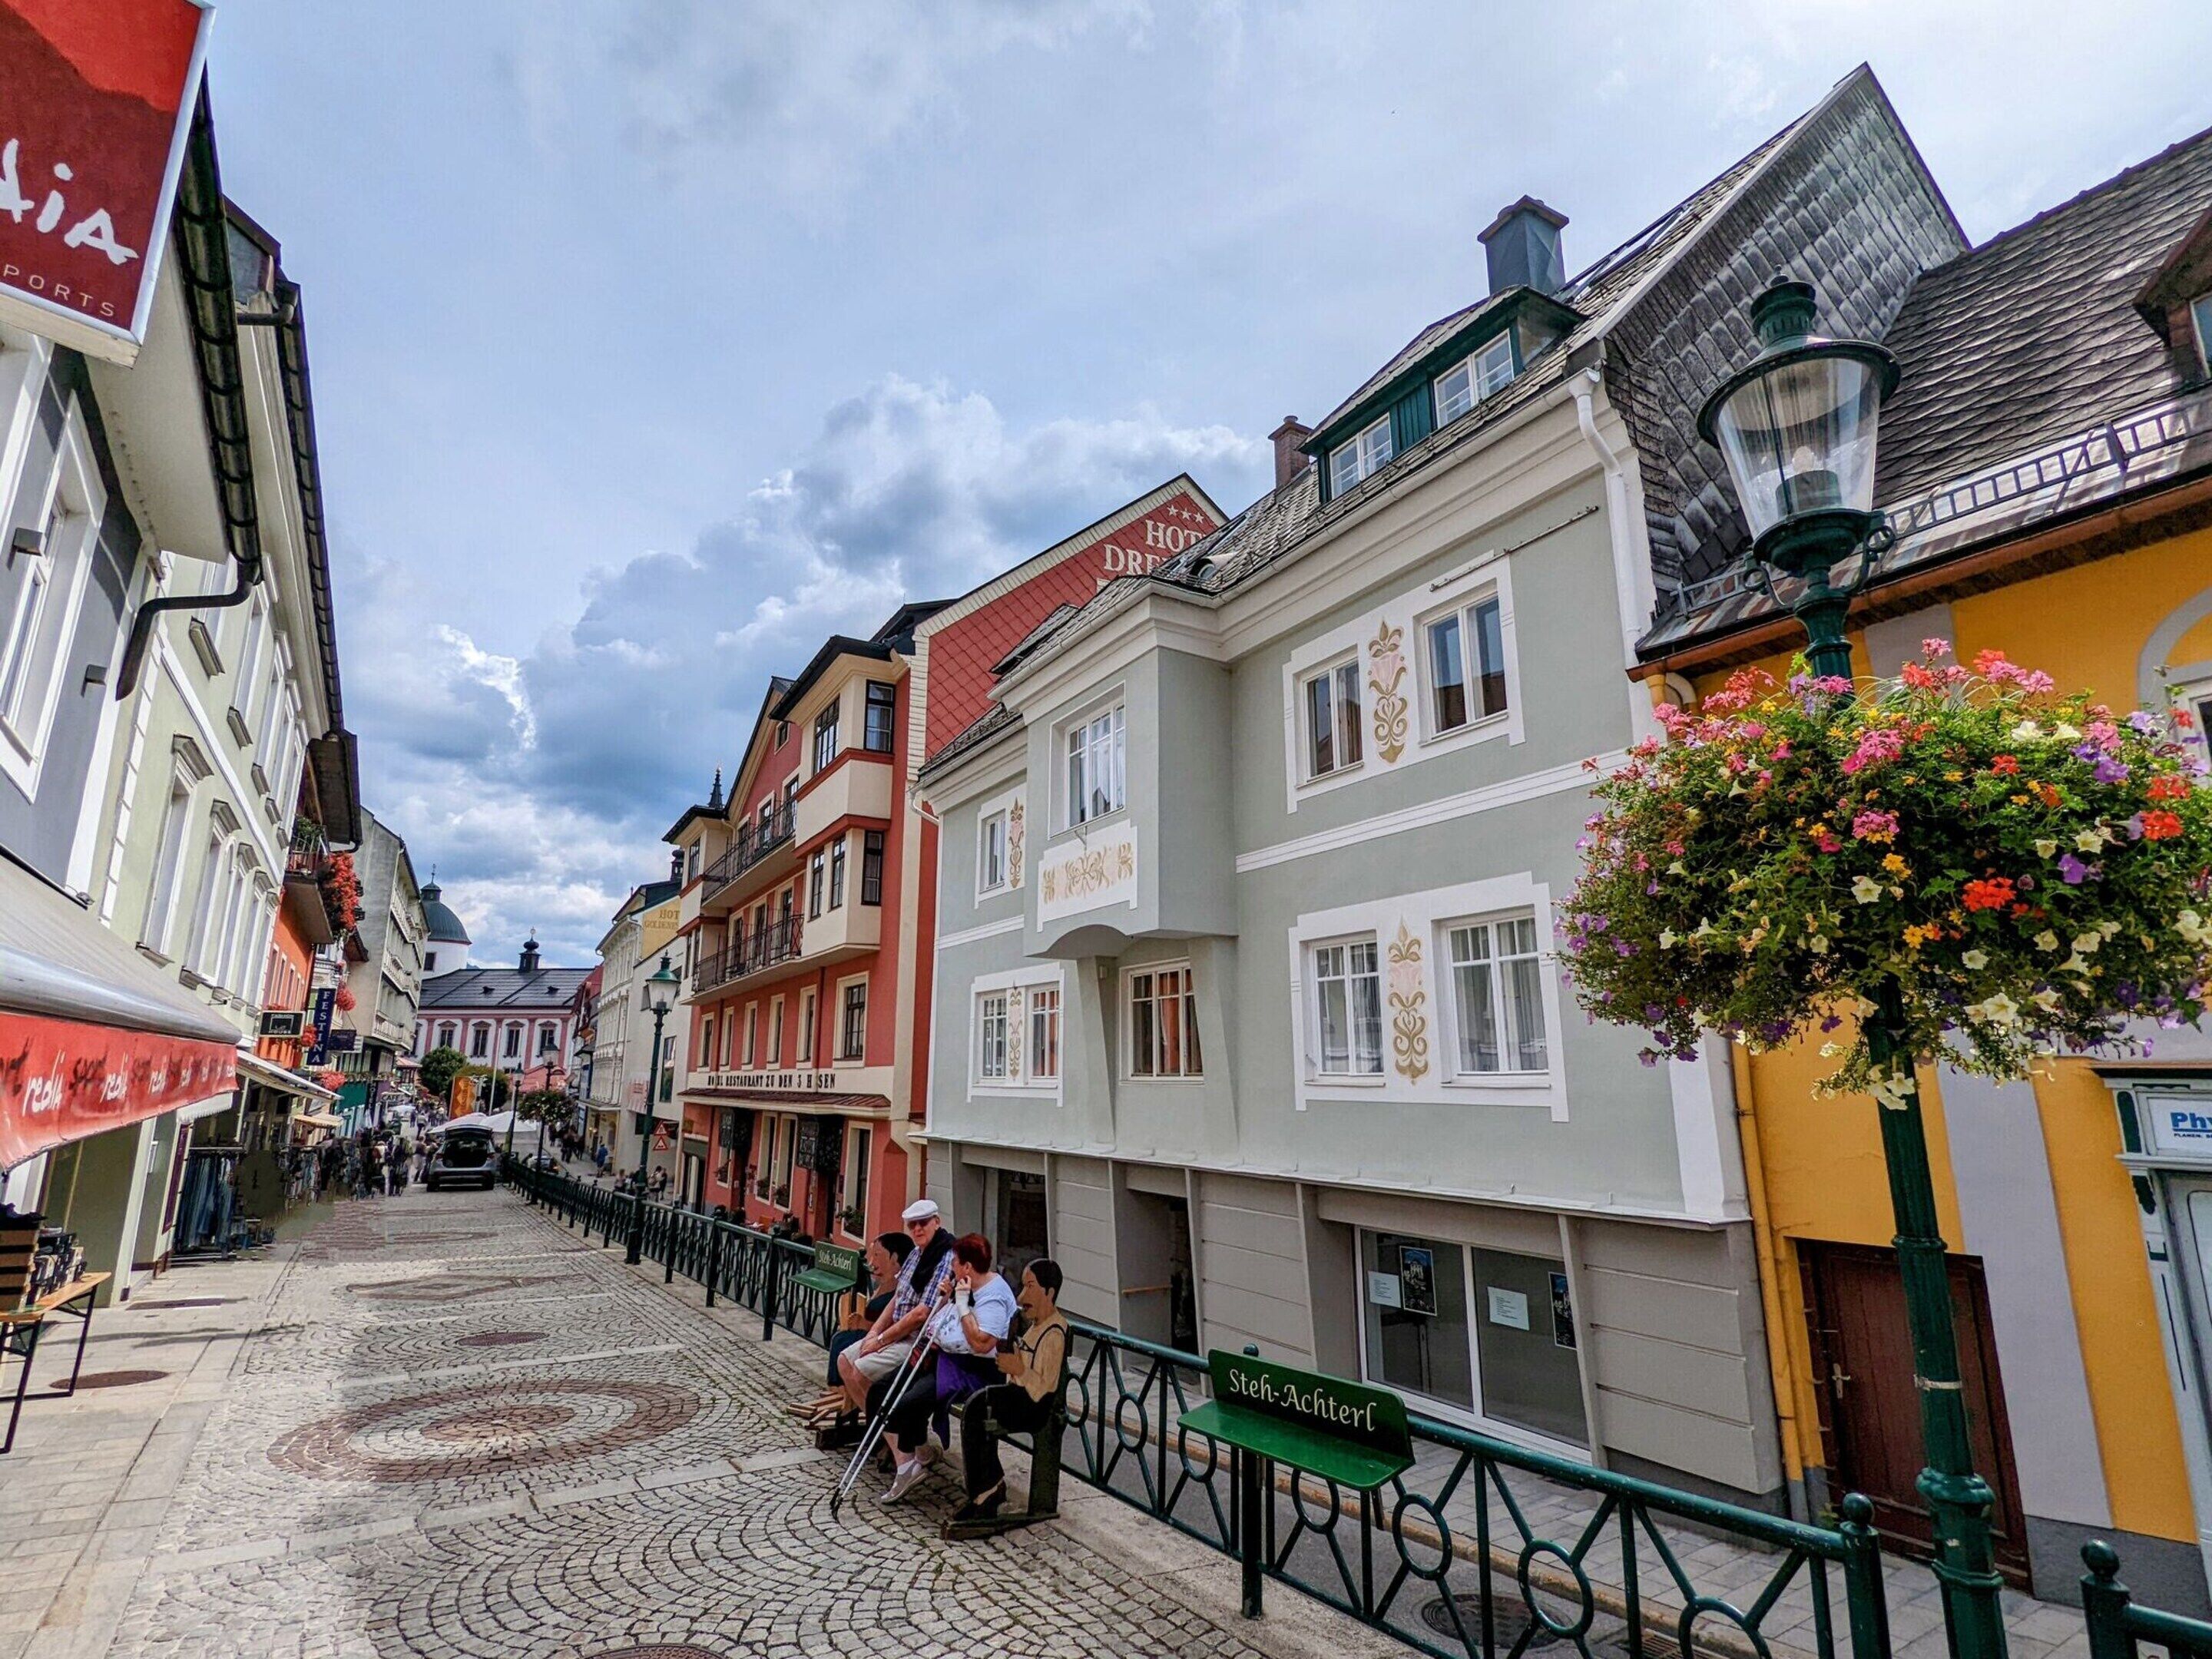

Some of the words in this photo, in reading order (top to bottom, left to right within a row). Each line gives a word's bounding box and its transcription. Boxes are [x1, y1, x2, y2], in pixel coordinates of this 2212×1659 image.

[3, 264, 114, 316] PORTS
[311, 991, 330, 1063] FESTINA
[725, 1075, 763, 1088] RESTAURANT
[766, 1075, 775, 1088] ZU
[779, 1075, 793, 1088] DEN
[796, 1075, 802, 1088] 3
[806, 1074, 836, 1089] HSEN
[1230, 1369, 1377, 1432] Steh-Achterl
